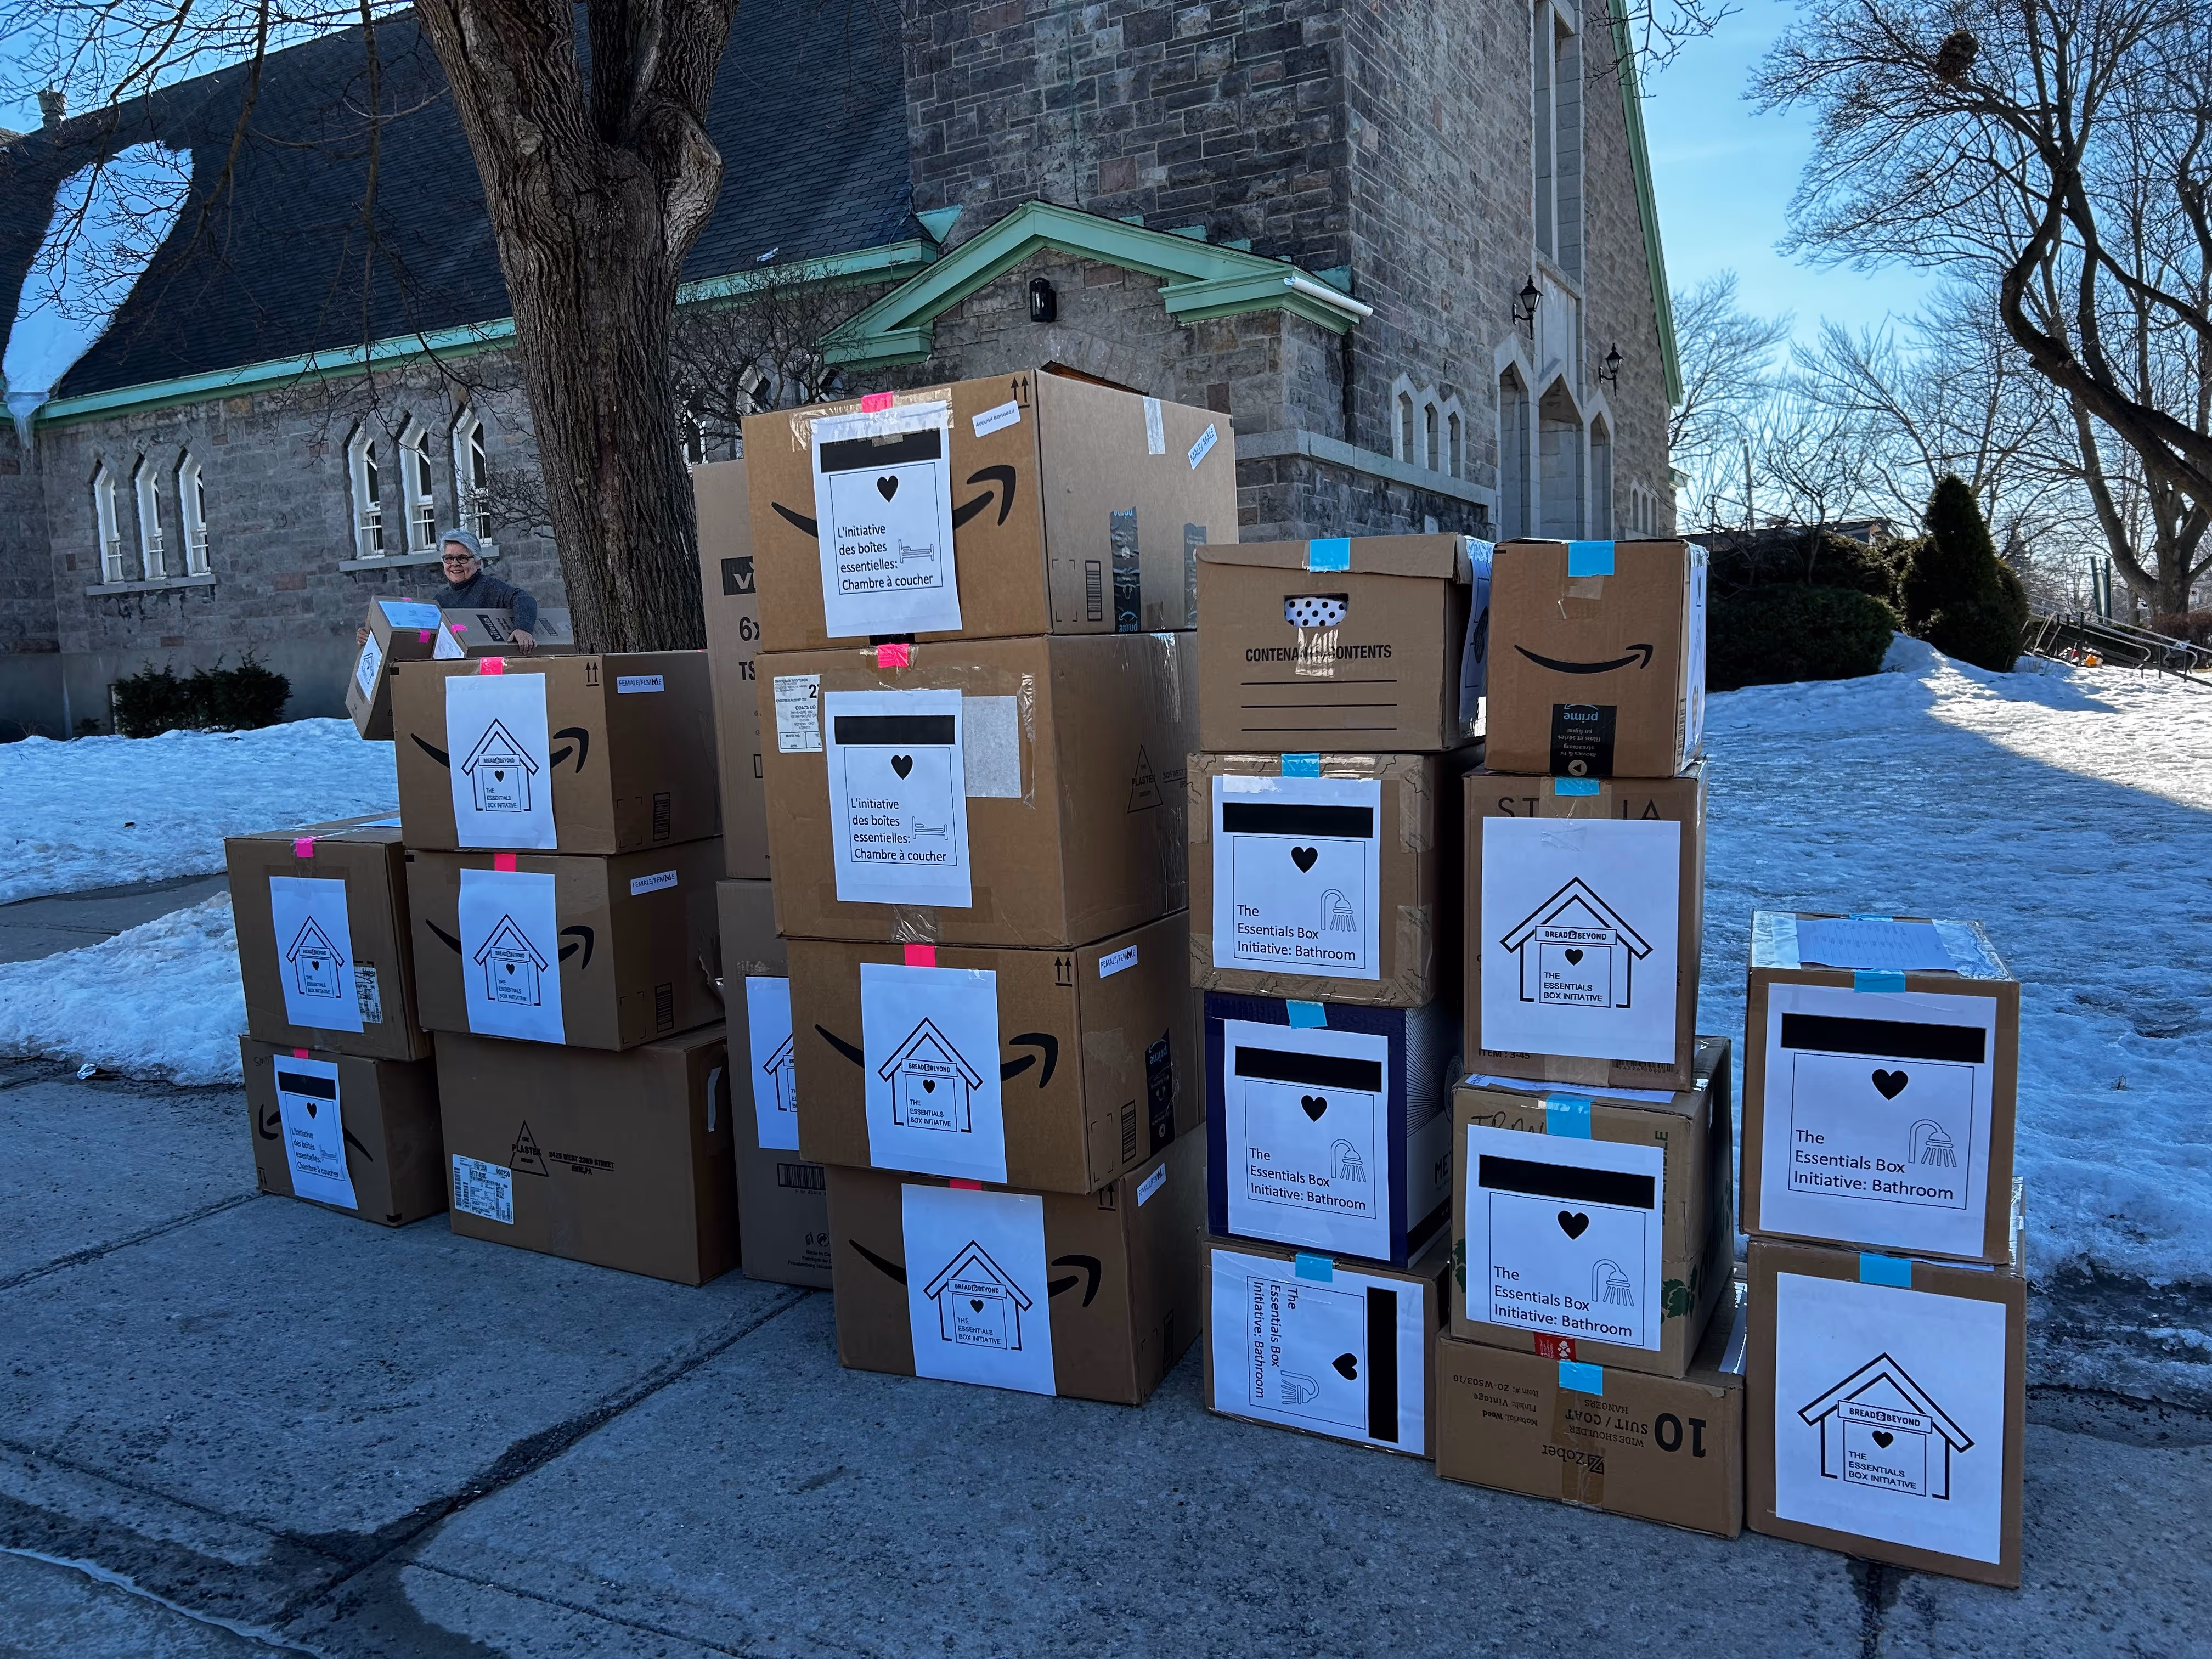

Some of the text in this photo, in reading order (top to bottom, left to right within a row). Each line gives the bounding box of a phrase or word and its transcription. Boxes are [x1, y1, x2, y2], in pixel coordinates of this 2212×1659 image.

[838, 523, 886, 538] L'initiative
[839, 541, 887, 556] des boîtes
[841, 558, 898, 573] essentielles:
[842, 573, 933, 590] Chambre à coucher
[1564, 712, 1599, 723] prime
[1132, 774, 1155, 786] PLASTEK
[851, 798, 899, 809] L'initiative
[853, 815, 900, 826] des boîtes
[854, 832, 911, 844] essentielles:
[855, 848, 946, 862] Chambre à coucher
[1237, 905, 1259, 916] The
[1238, 923, 1319, 939] Essentials Box
[1545, 930, 1606, 940] BREAD&BEYOND
[1238, 941, 1355, 960] Initiative: Bathroom
[1544, 982, 1593, 991] ESSENTIALS
[1564, 993, 1602, 1002] INITIATIVE
[1150, 1047, 1167, 1064] prime
[1479, 1048, 1502, 1057] ITEM
[909, 1063, 950, 1073] BREAD&BEYOND
[910, 1108, 944, 1118] ESSENTIALS
[924, 1118, 951, 1127] INITIATIVE
[1796, 1130, 1824, 1144] The
[512, 1144, 541, 1156] PLASTEK
[1249, 1148, 1271, 1161] The
[549, 1152, 614, 1169] 2425 WEST 23RD STREET
[1796, 1150, 1905, 1173] Essentials Box
[1251, 1165, 1330, 1187] Essentials Box
[1795, 1171, 1953, 1200] Initiative: Bathroom
[1251, 1183, 1365, 1210] Initiative: Bathroom
[1494, 1266, 1519, 1280] The
[955, 1283, 1000, 1294] BREAD&BEYOND
[1288, 1288, 1298, 1310] The
[1494, 1285, 1590, 1311] Essentials Box
[1271, 1284, 1282, 1367] Essentials Box
[1495, 1304, 1632, 1336] Initiative: Bathroom
[958, 1325, 993, 1335] ESSENTIALS
[973, 1335, 1001, 1344] INITIATIVE
[1254, 1282, 1266, 1398] Initiative: Bathroom
[1522, 1389, 1539, 1397] Item
[1474, 1393, 1537, 1412] Finish: Vintage
[1585, 1398, 1628, 1414] HANGERS
[1483, 1410, 1503, 1420] Wood
[1565, 1409, 1601, 1425] COAT
[1849, 1407, 1920, 1426] BREAD&BEYOND
[1615, 1418, 1648, 1435] SUIT
[1570, 1425, 1645, 1447] WIDE SHOULDER
[1654, 1412, 1706, 1458] 10
[1541, 1444, 1586, 1465] Zober
[1848, 1451, 1867, 1460] THE
[1849, 1461, 1905, 1477] ESSENTIALS
[1849, 1470, 1916, 1489] BOX INITIATIVE
